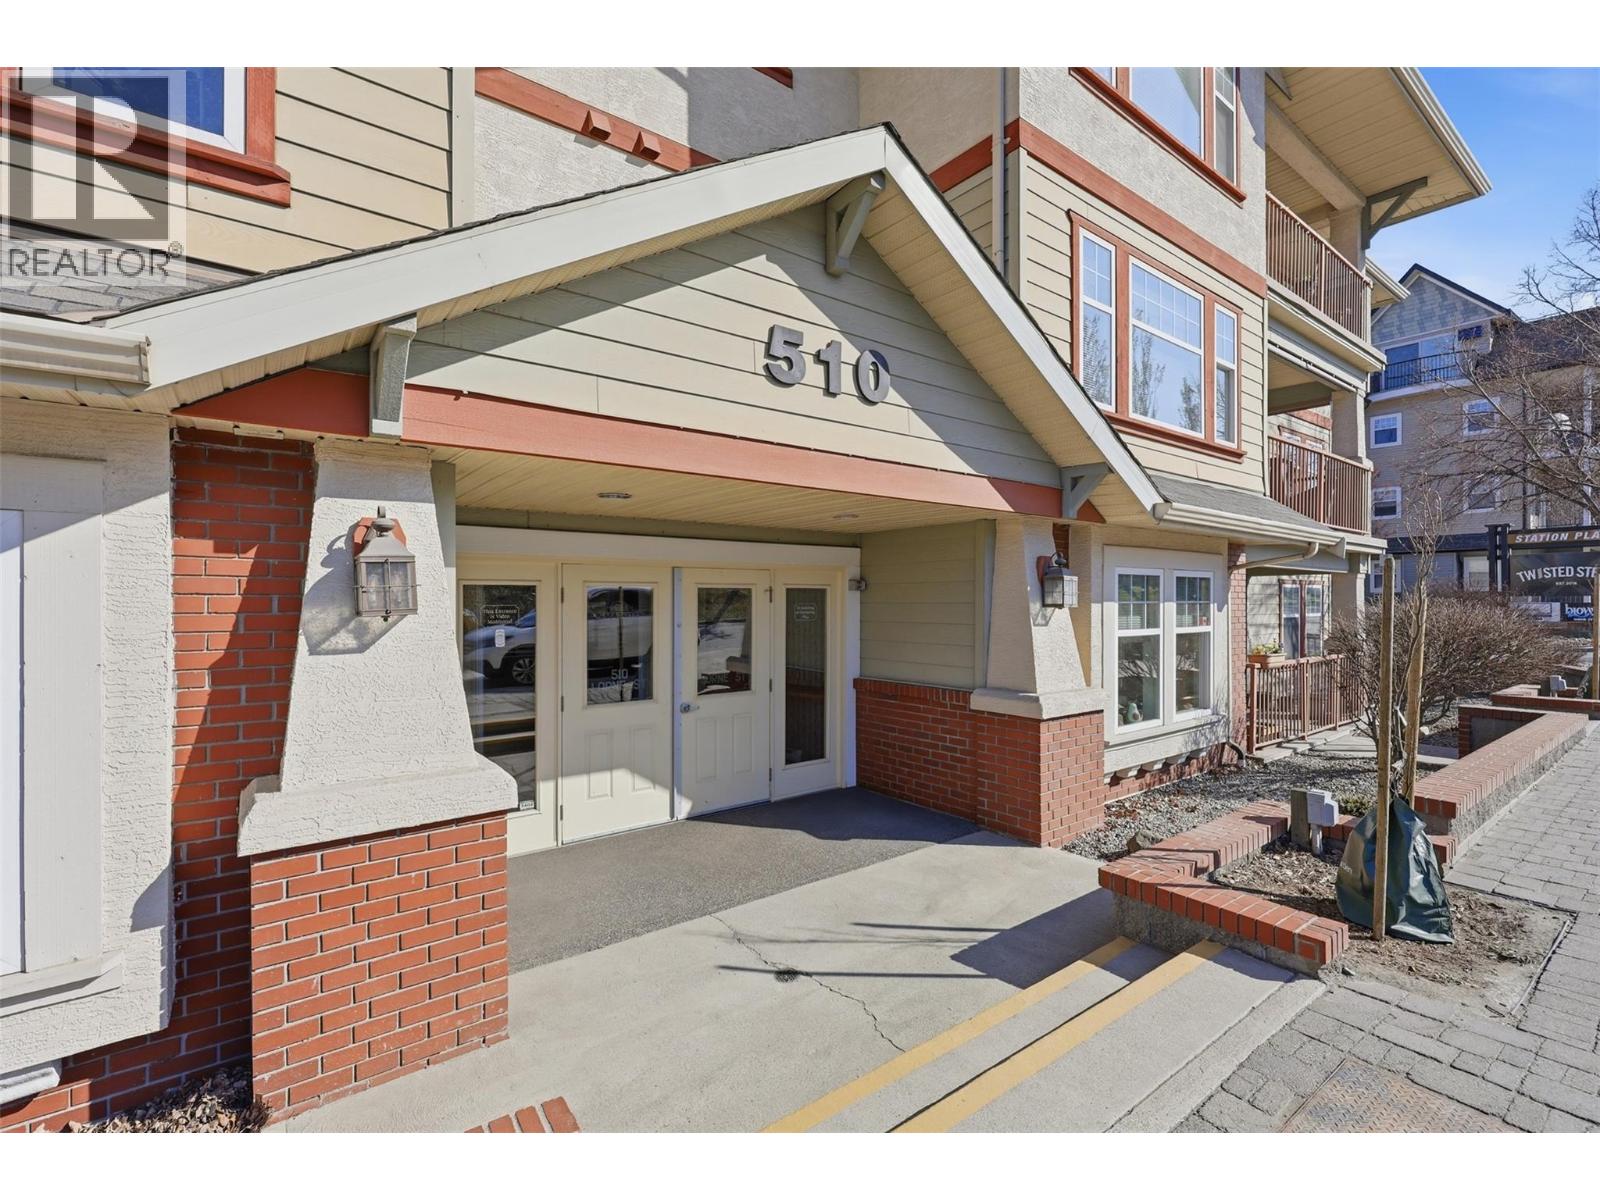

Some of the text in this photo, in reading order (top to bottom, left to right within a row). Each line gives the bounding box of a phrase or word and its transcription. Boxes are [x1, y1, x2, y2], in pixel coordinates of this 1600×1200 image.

[764, 324, 891, 406] 510
[1515, 532, 1569, 544] STATION
[1516, 566, 1574, 582] TWISTED
[611, 668, 629, 680] 510
